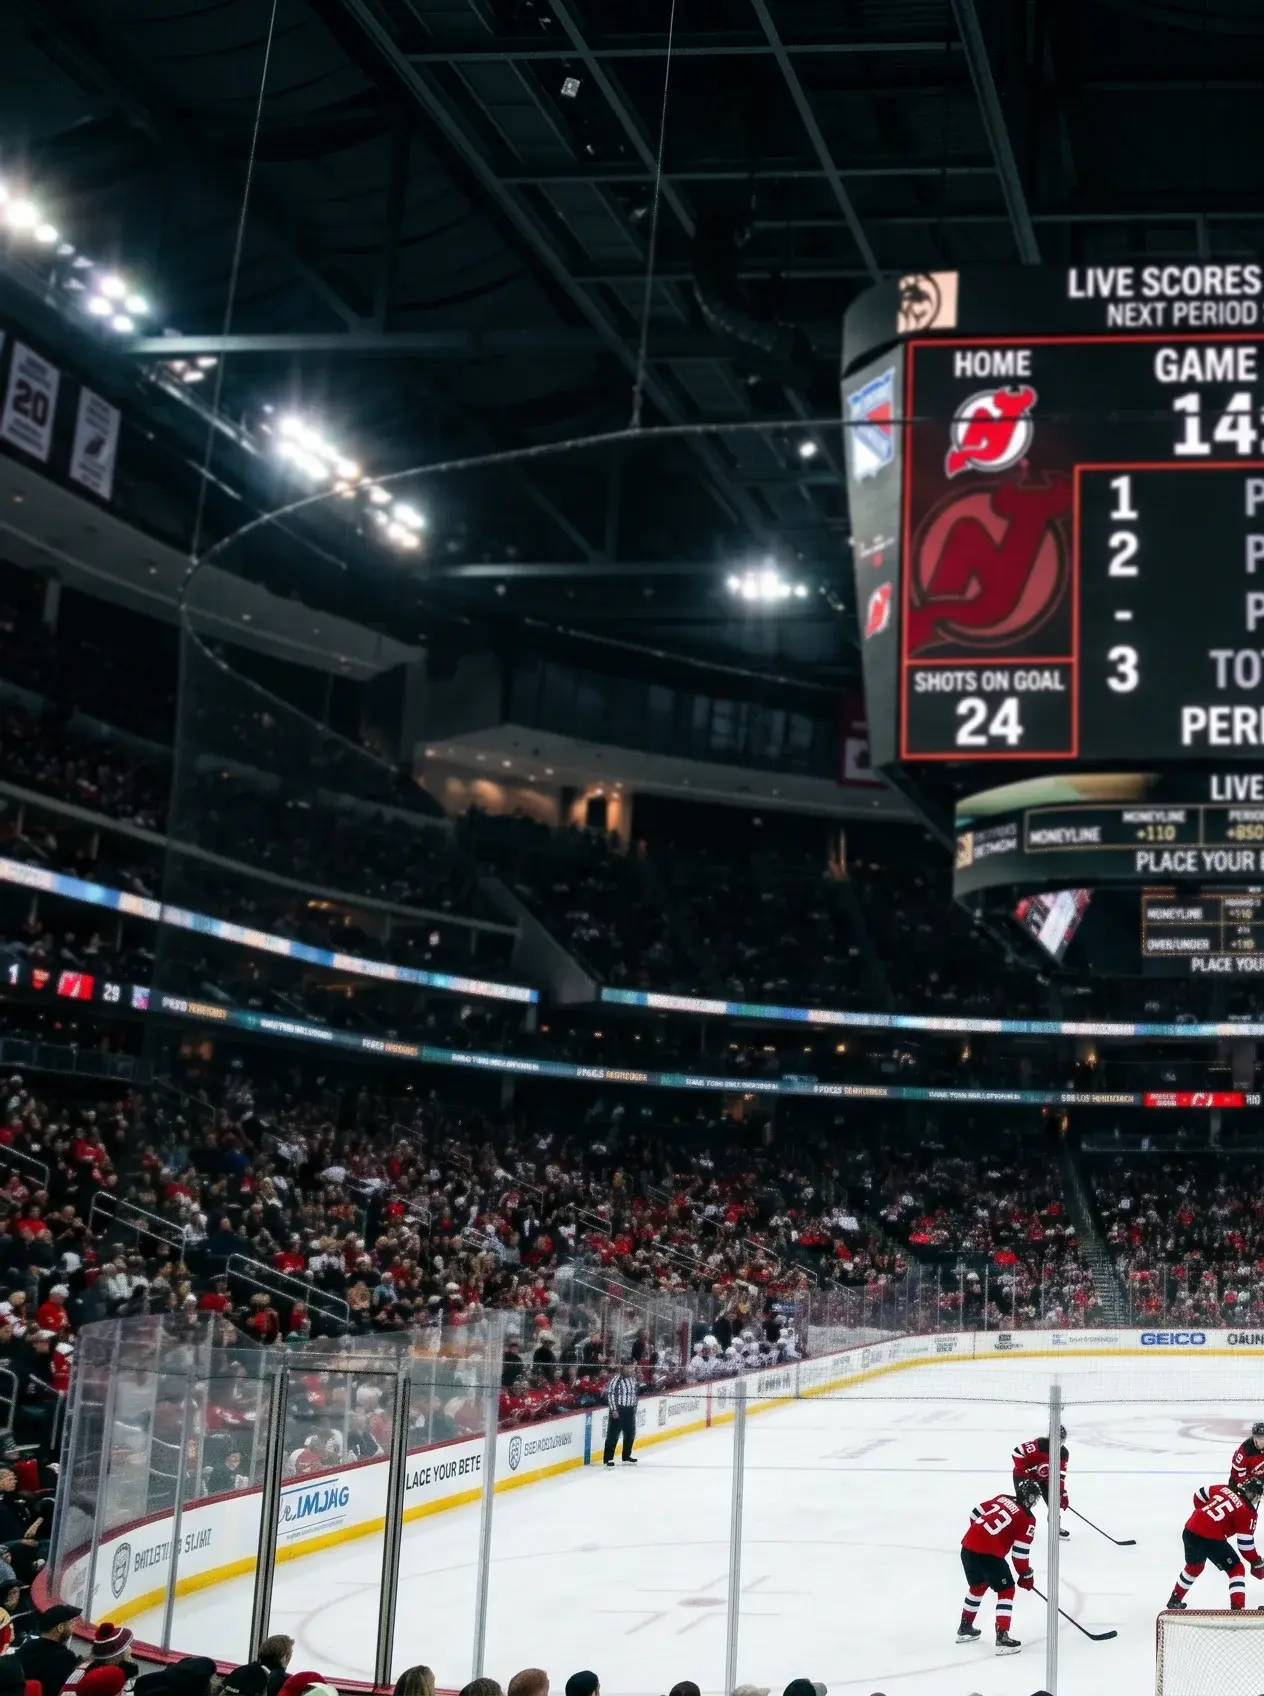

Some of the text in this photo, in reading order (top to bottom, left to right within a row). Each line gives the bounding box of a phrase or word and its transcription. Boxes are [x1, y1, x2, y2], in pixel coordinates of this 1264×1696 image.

[1068, 267, 1134, 298] LIVE
[1142, 265, 1262, 296] SCORES
[1107, 302, 1167, 327] NEXT
[1173, 301, 1257, 326] PERIOD
[955, 351, 1032, 378] HOME
[1155, 348, 1257, 383] GAME
[12, 378, 49, 428] 20
[1110, 475, 1138, 520] 1
[1108, 531, 1139, 577] 2
[914, 671, 1065, 692] SHOTS ON GOAL
[1107, 646, 1140, 693] 3
[956, 698, 1023, 745] 24
[1211, 775, 1264, 800] LIVE
[1029, 827, 1101, 844] MONEYLINE
[1136, 851, 1198, 872] PLACE
[1202, 851, 1255, 872] YOUR
[1191, 957, 1232, 973] PLACE
[1140, 1332, 1207, 1346] GEICO
[405, 1465, 431, 1491] LACE
[433, 1460, 457, 1482] YOUR
[1202, 1494, 1235, 1522] 15
